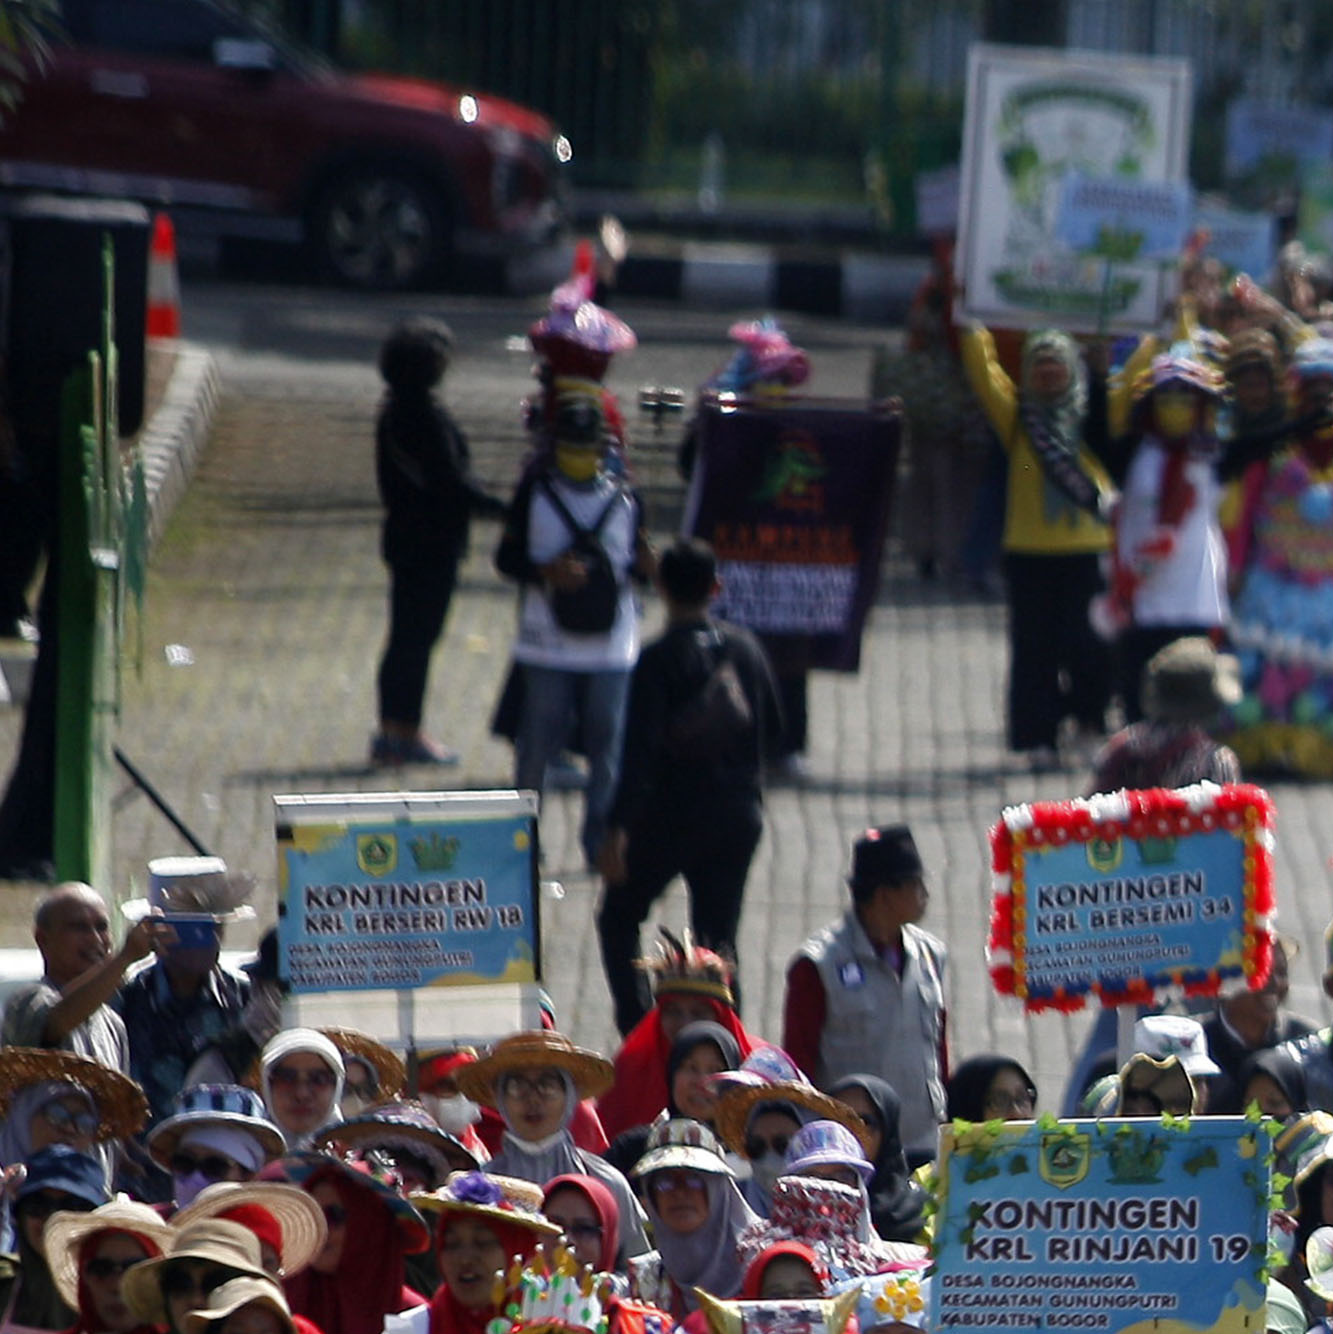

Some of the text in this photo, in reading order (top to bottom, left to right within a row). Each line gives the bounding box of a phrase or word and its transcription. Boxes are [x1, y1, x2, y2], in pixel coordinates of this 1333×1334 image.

[304, 878, 485, 911] KONTINGEN
[1037, 871, 1205, 909] KONTINGEN
[304, 911, 344, 935] KRL
[354, 908, 446, 934] BERSERI
[1036, 911, 1081, 935] KRL
[1090, 903, 1192, 930] BERSEMI
[969, 1198, 1199, 1232] KONTINGEN
[964, 1235, 1250, 1264] KRL RINJANI 19
[941, 1273, 1138, 1290] DESA BOJONGNANGKA
[940, 1292, 1178, 1310] KECAMATAN GUNUNGPUTRI
[940, 1311, 1108, 1328] KABUPATEN BOGOR
